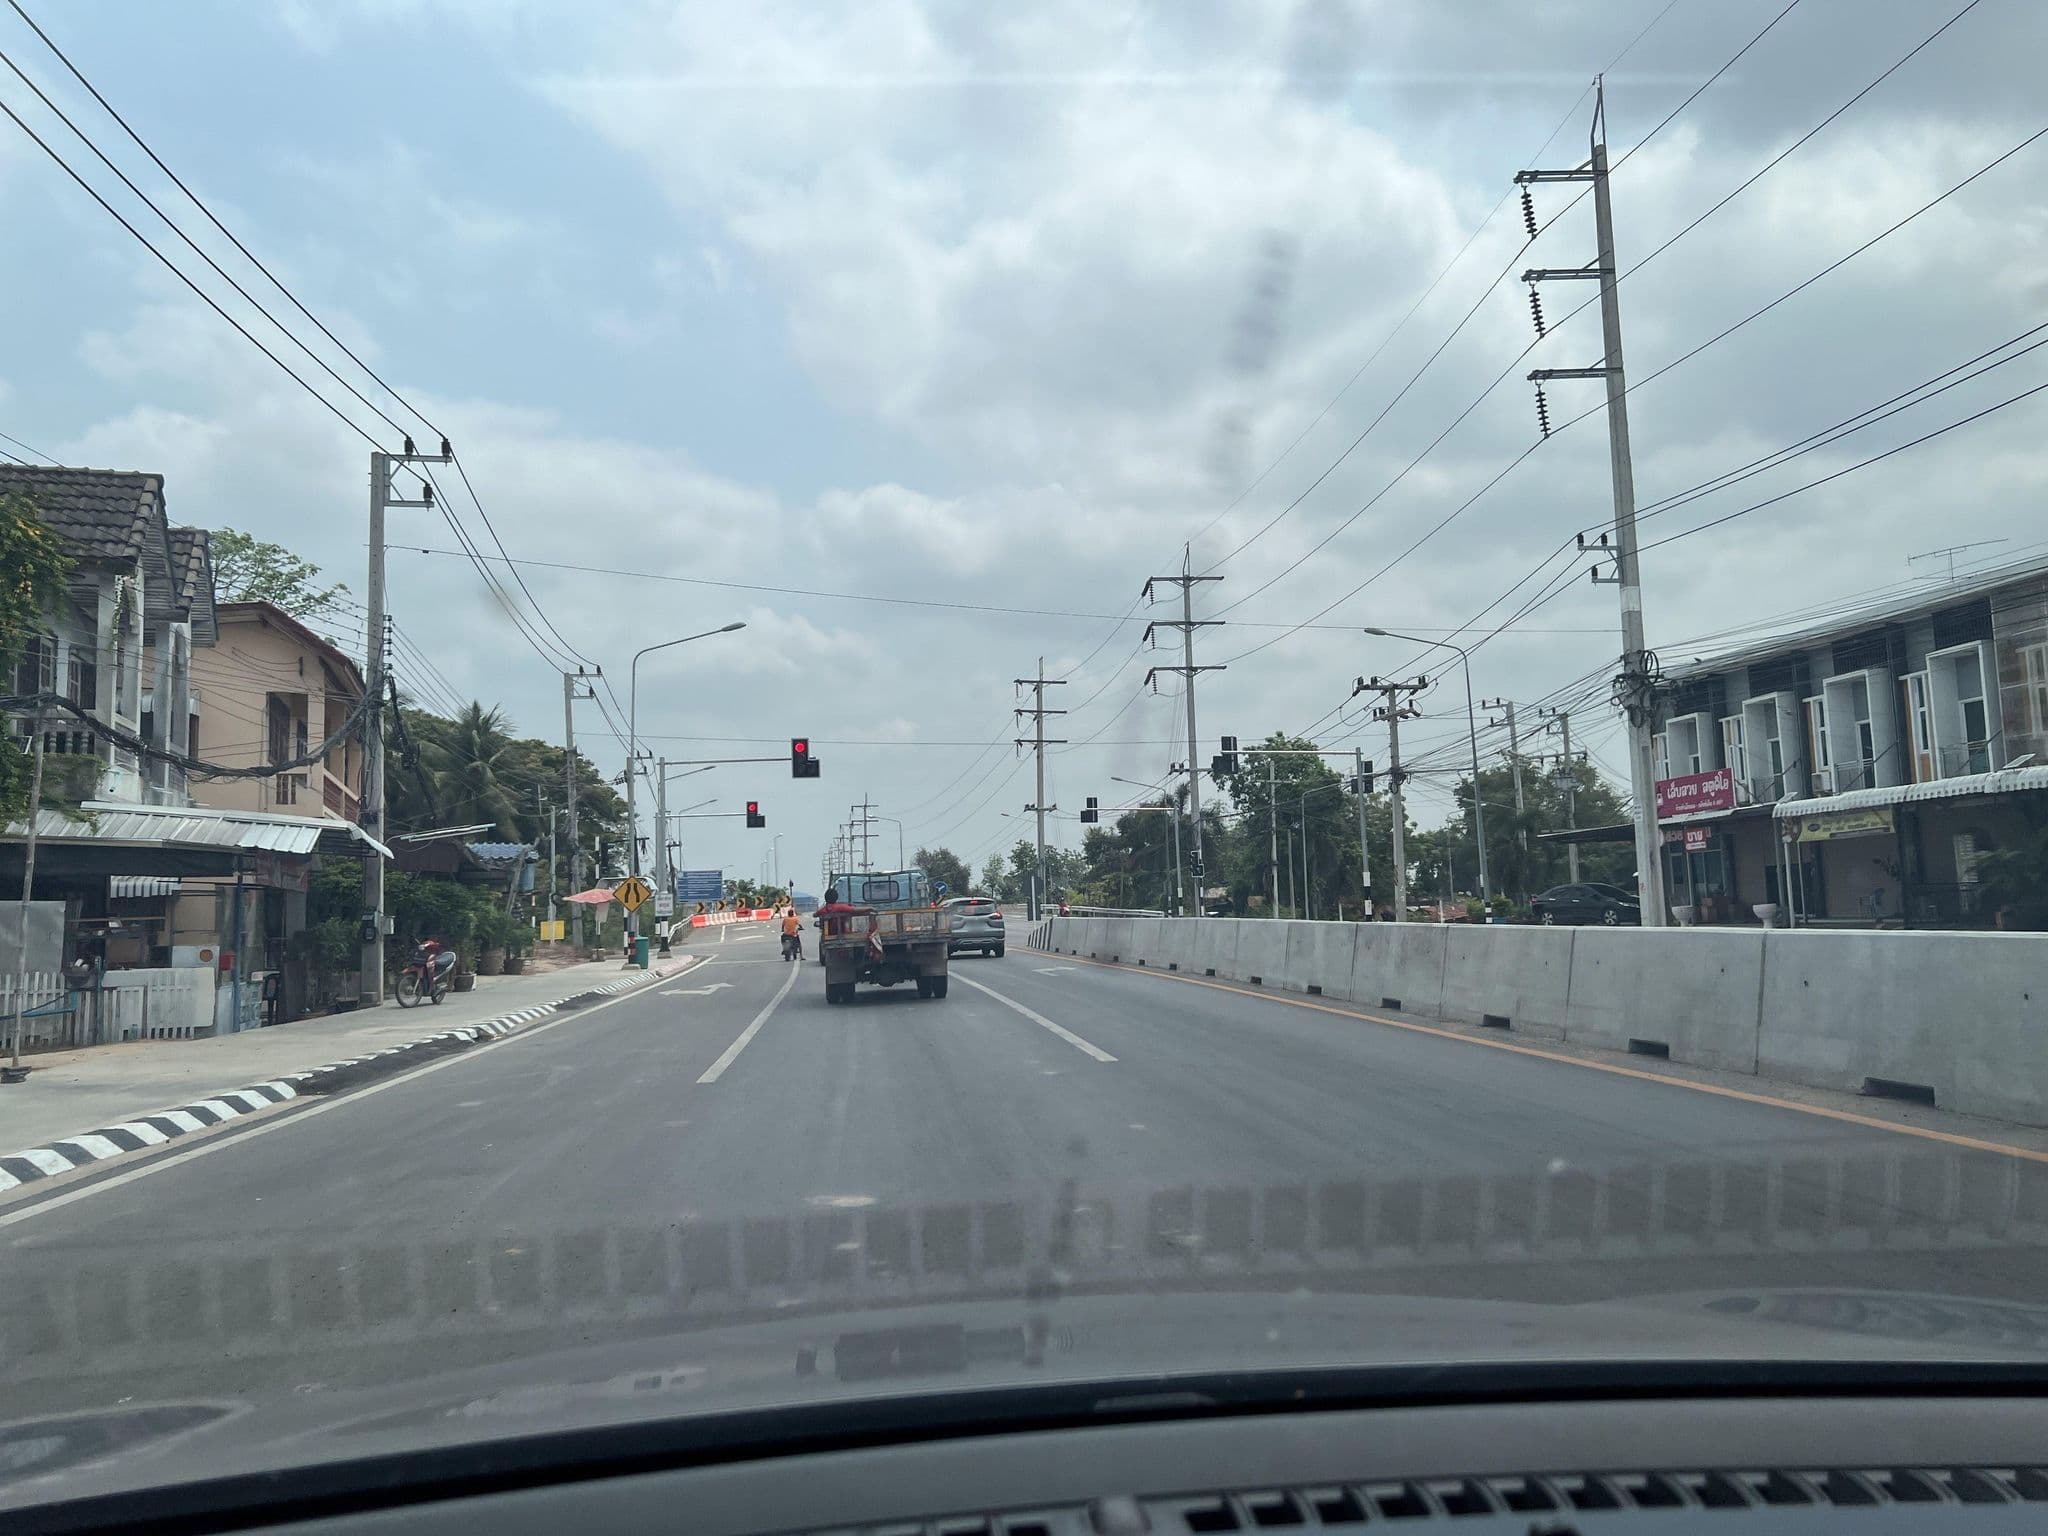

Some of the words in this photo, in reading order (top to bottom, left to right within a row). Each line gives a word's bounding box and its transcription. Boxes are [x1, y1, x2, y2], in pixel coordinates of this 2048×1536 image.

[1667, 781, 1697, 799] เล็บสวย
[1702, 771, 1728, 797] สตูดิโอ
